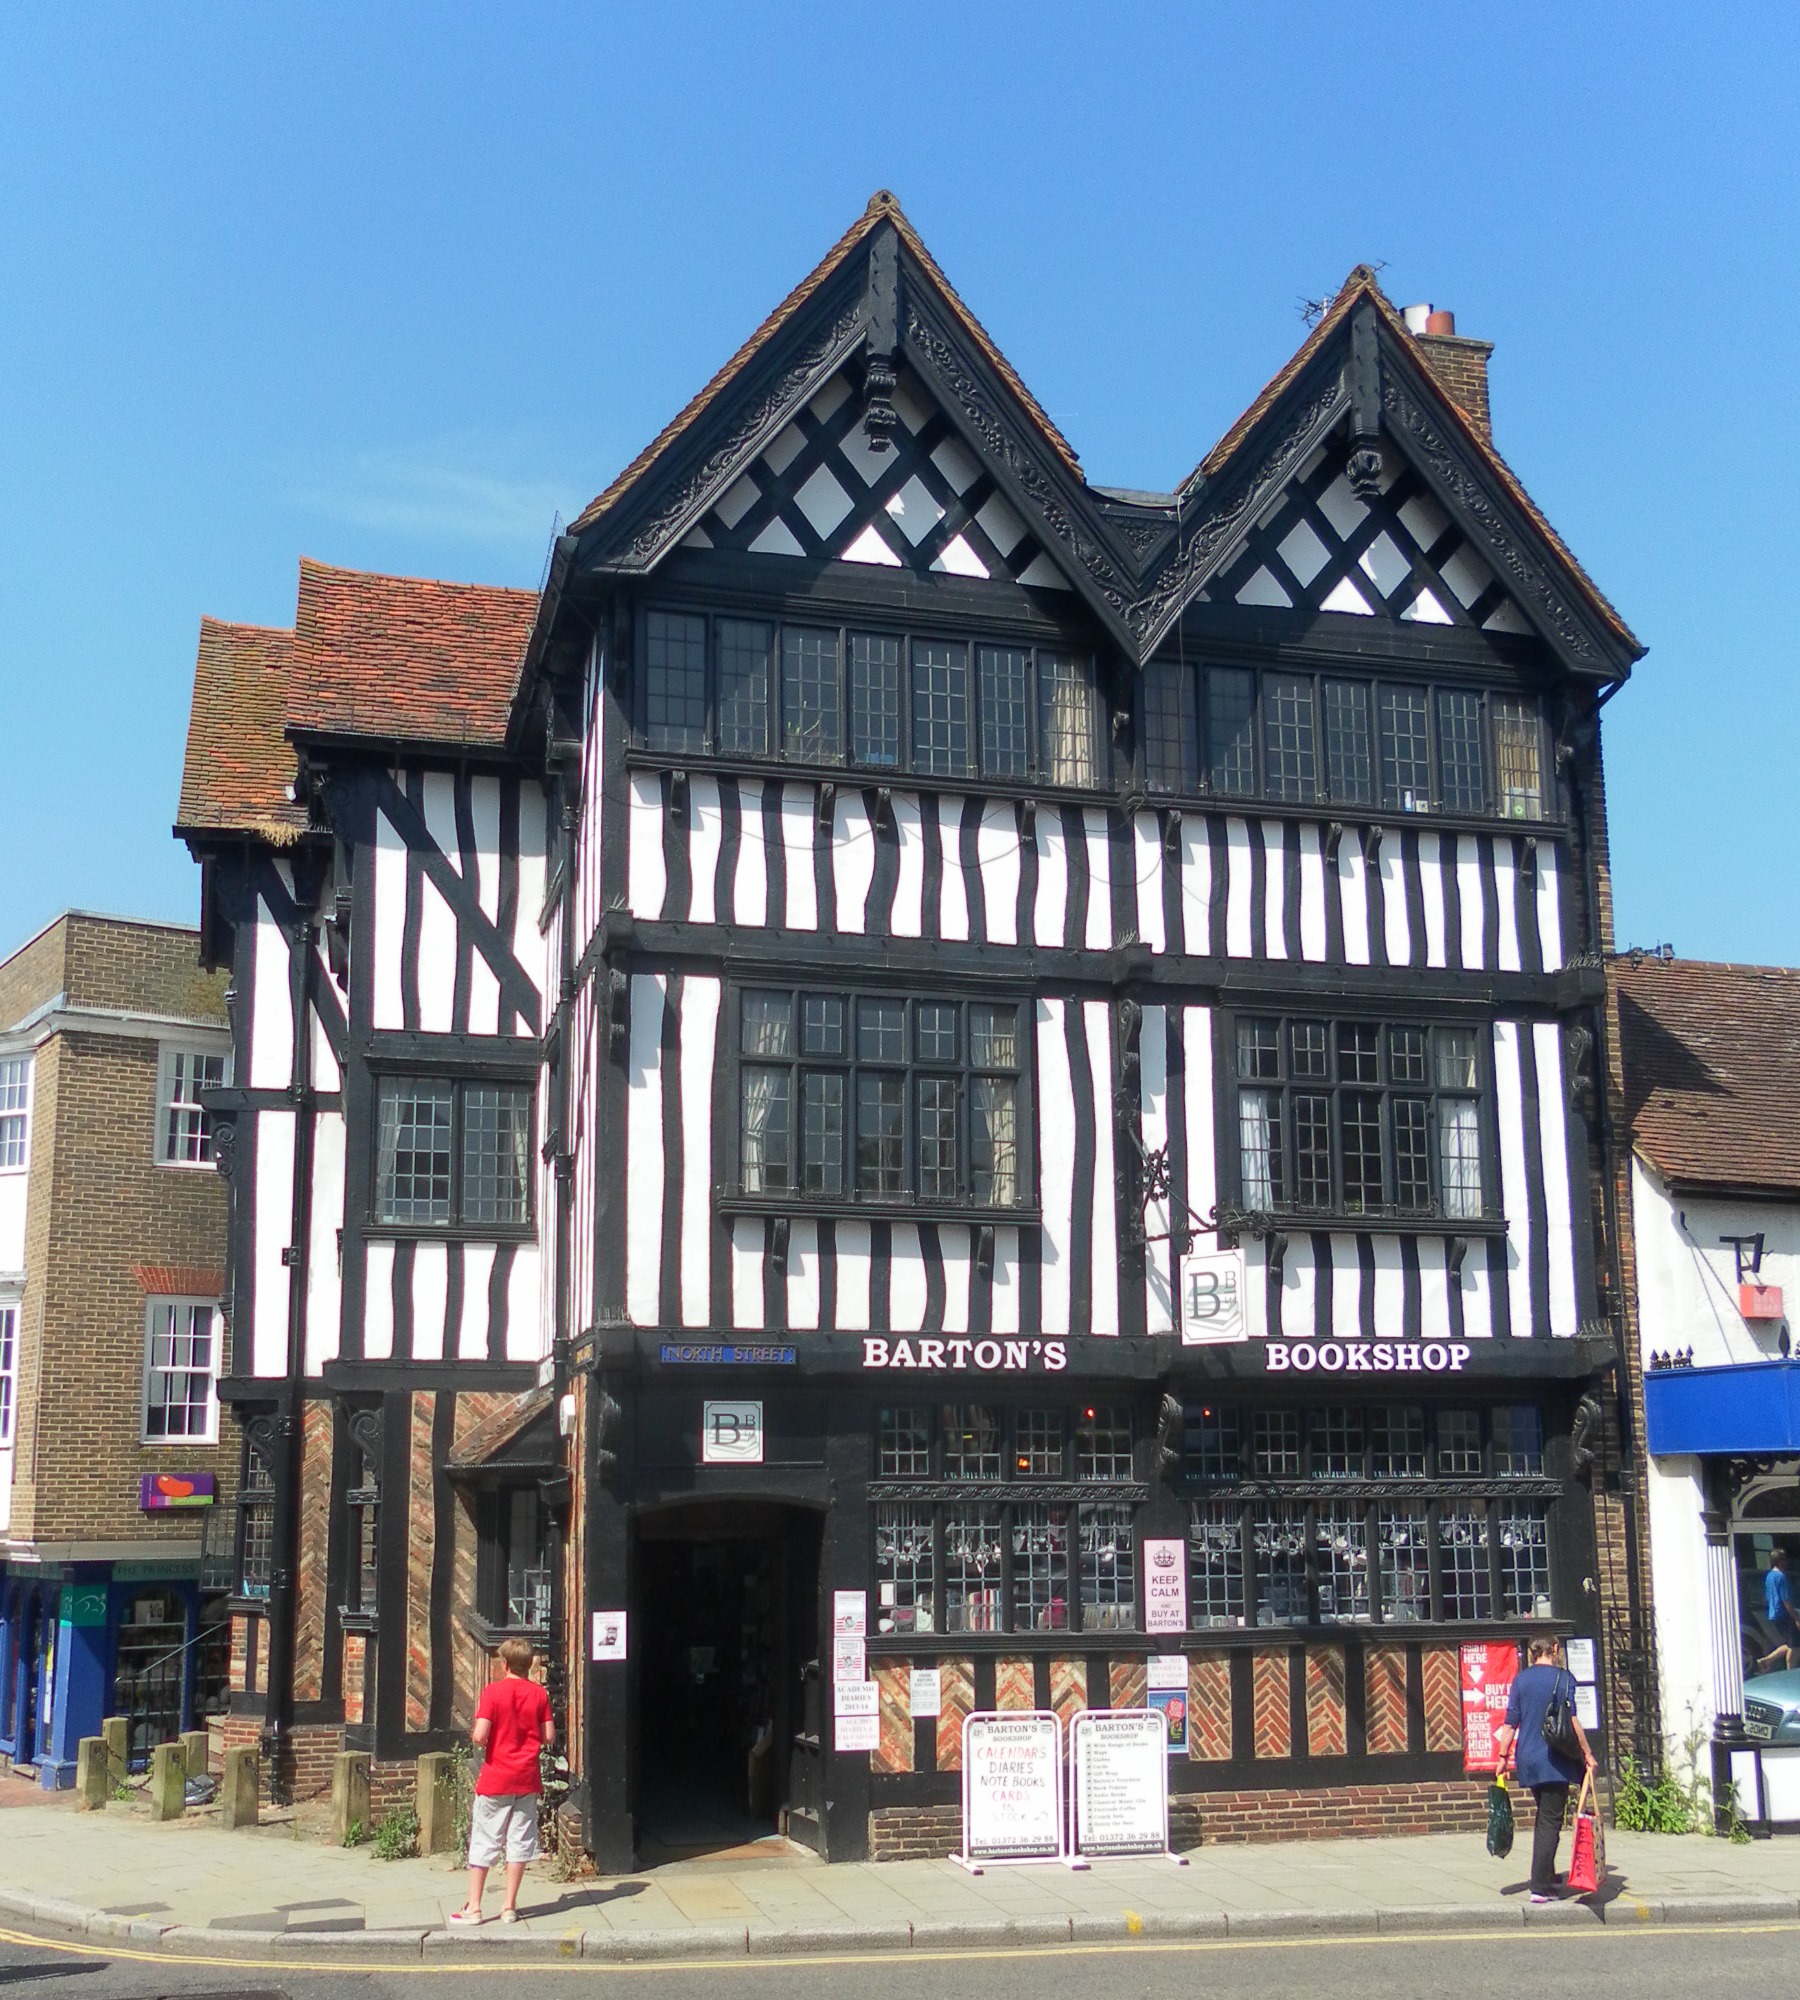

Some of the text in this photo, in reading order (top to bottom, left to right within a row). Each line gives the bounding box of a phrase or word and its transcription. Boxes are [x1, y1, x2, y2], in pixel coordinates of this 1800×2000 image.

[666, 1345, 788, 1363] NORTH STREET
[863, 1338, 1068, 1370] BARTON'S
[1265, 1343, 1471, 1371] BOOKSHOP
[117, 1564, 195, 1575] THE PRINCESS
[1152, 1575, 1178, 1585] KEEP
[1151, 1588, 1180, 1597] CALM
[1151, 1610, 1168, 1618] BUY
[1147, 1619, 1184, 1627] BARTON'S
[1463, 1652, 1488, 1664] HERE
[837, 1685, 875, 1693] ACADEMIC
[1485, 1683, 1505, 1696] BUY
[1485, 1695, 1509, 1709] HER
[1466, 1711, 1490, 1722] KEEP
[987, 1724, 1038, 1734] BARTON'S
[1095, 1722, 1144, 1732] BARTON'S
[1467, 1722, 1490, 1731] BOOKS
[1467, 1730, 1490, 1739] ON THE
[1467, 1738, 1491, 1750] HIGH
[977, 1746, 1047, 1760] CALENDARS
[1468, 1750, 1492, 1758] STREET
[989, 1761, 1034, 1774] DIARIES
[980, 1775, 1046, 1788] NOTE BOOKS
[992, 1790, 1030, 1801] CARDS
[1099, 1833, 1124, 1841] 01372
[1138, 1832, 1148, 1840] 29
